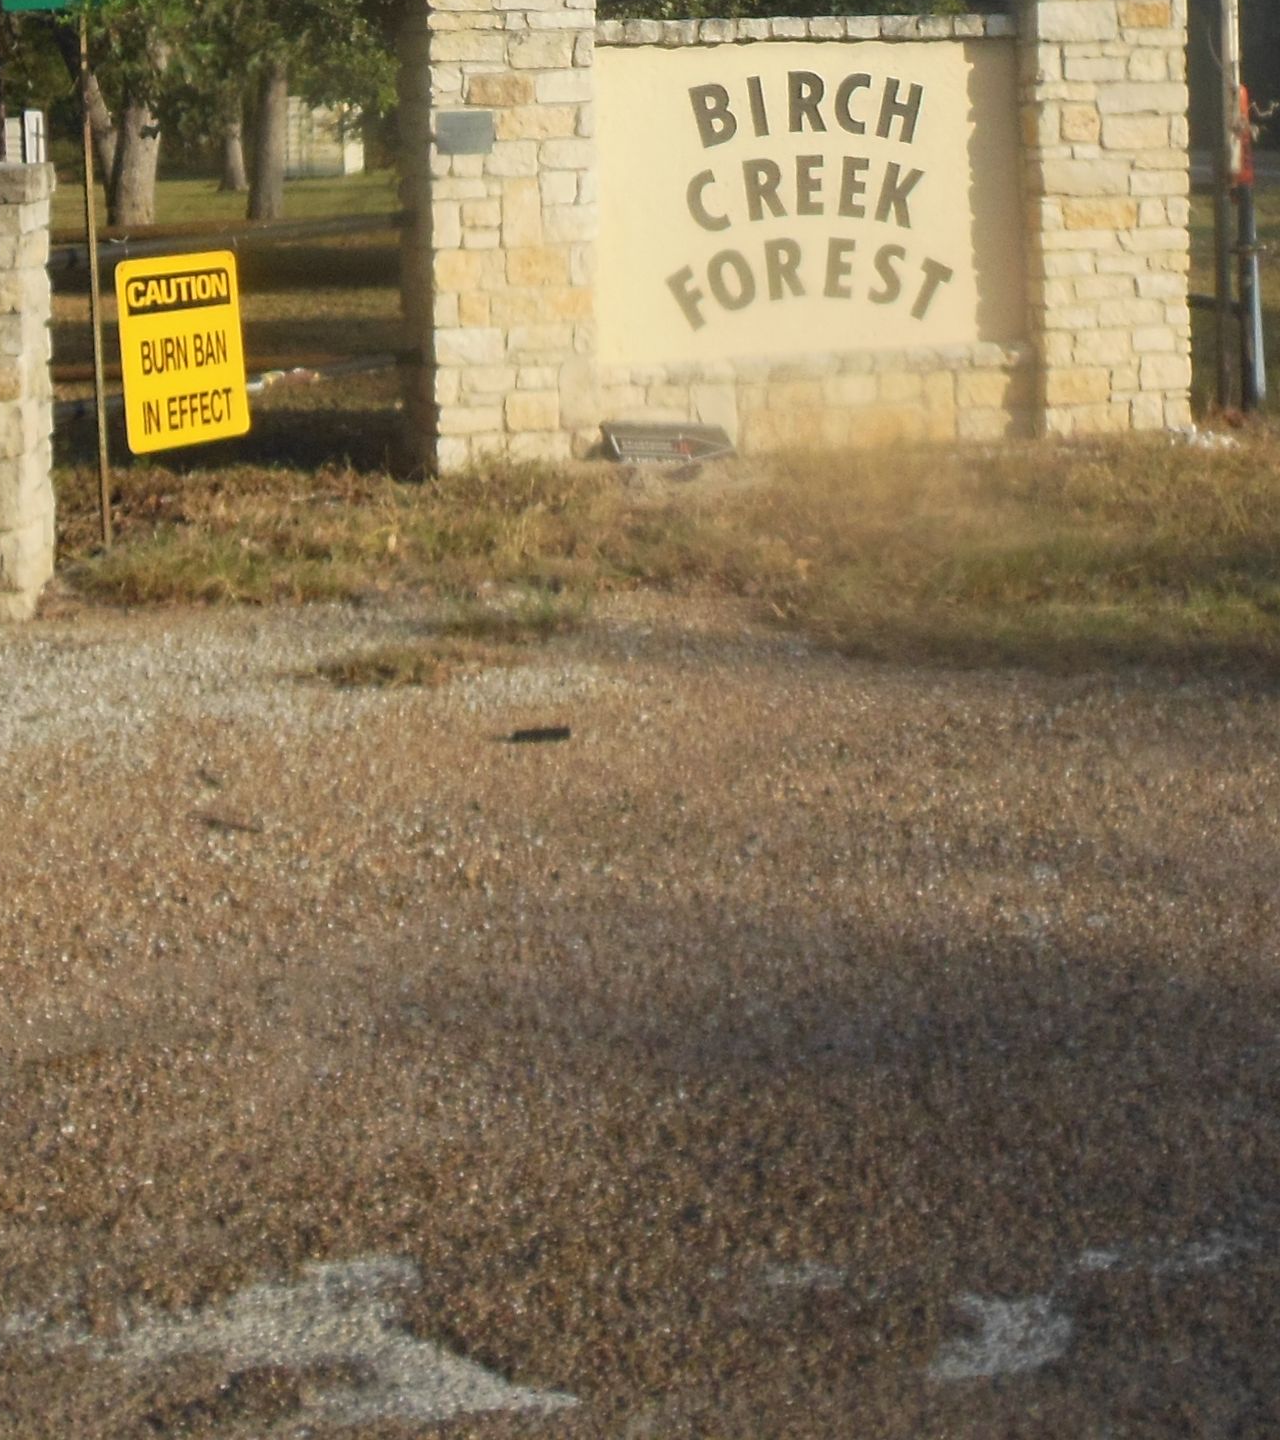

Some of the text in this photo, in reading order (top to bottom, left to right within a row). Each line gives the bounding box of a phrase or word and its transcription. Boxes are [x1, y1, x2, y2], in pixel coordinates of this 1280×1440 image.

[687, 70, 924, 148] BIRCH
[686, 154, 926, 232] CREEK
[127, 272, 228, 307] CAUTION
[665, 236, 954, 332] FOREST
[140, 329, 228, 375] BURN BAN
[142, 387, 232, 435] IN EFFECT
